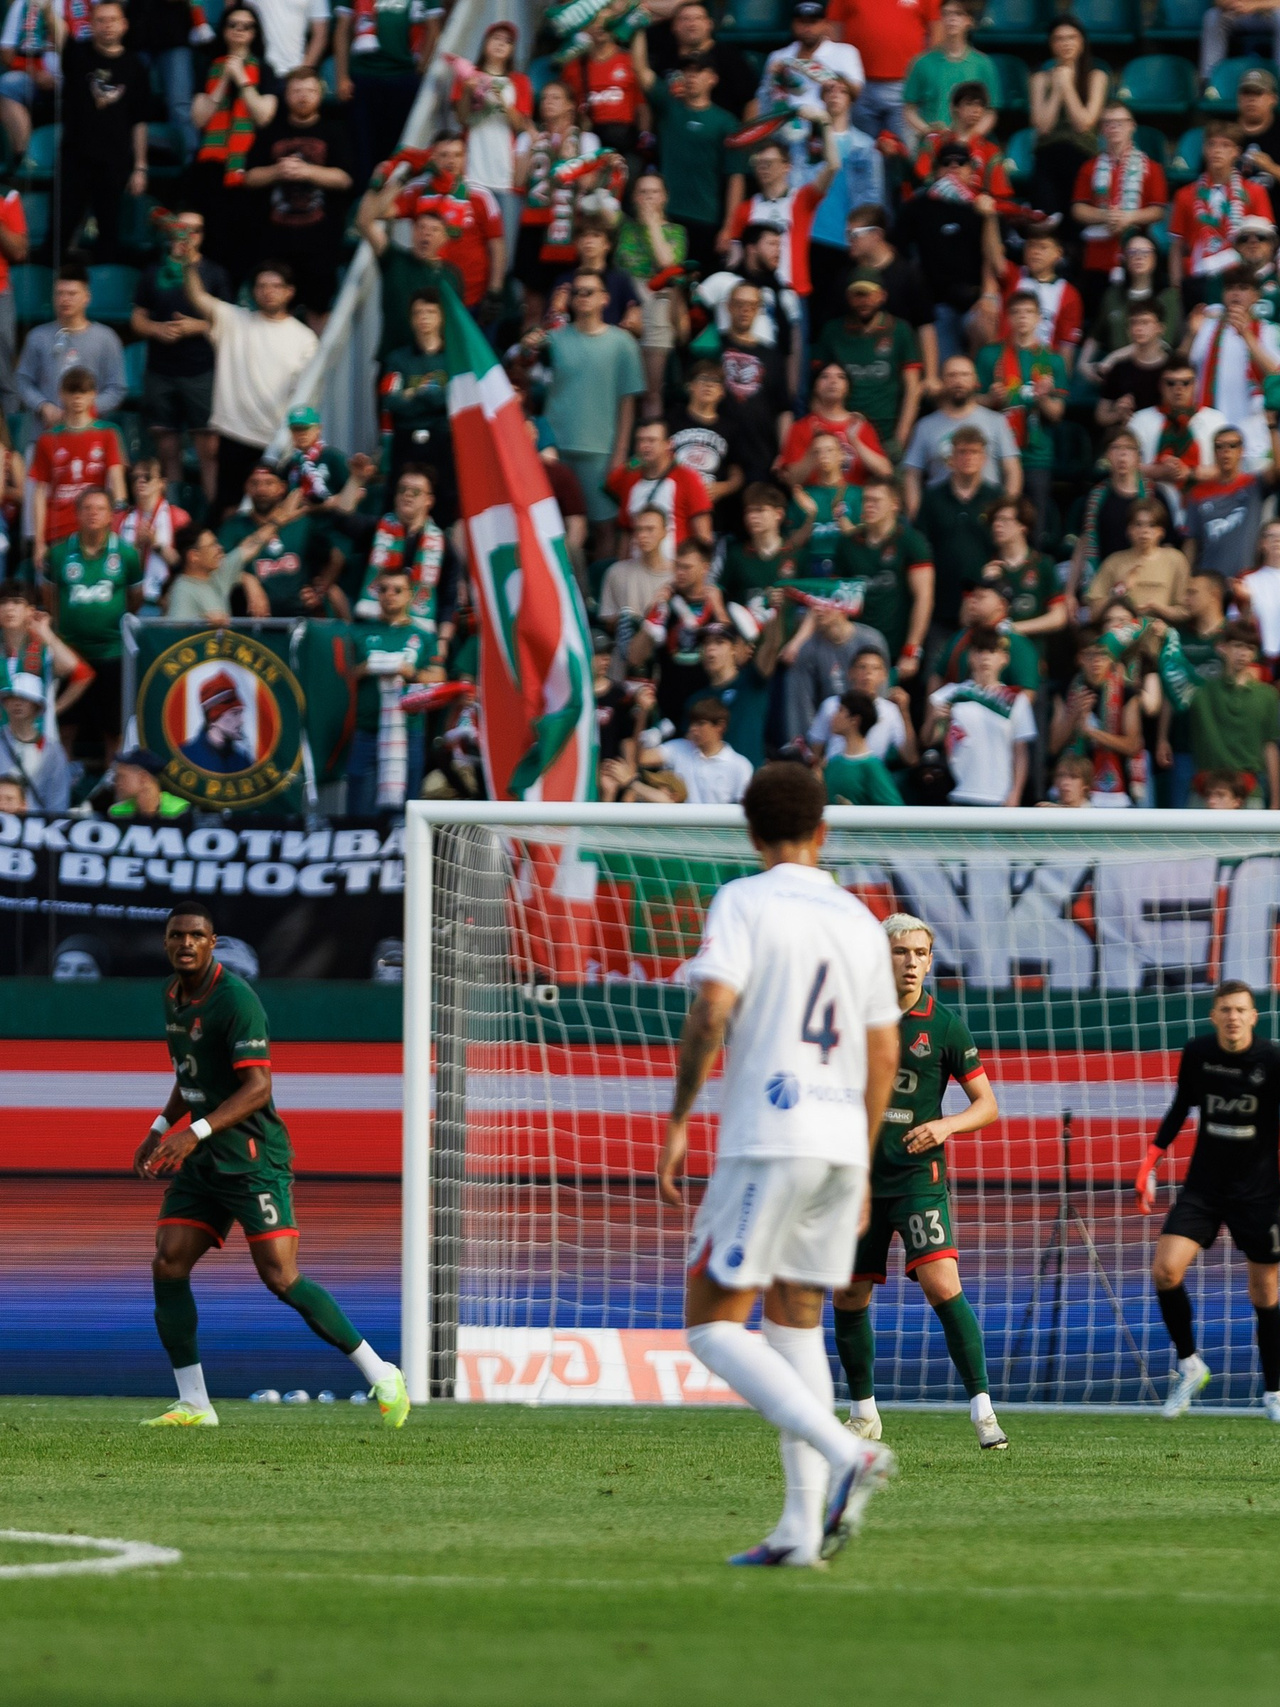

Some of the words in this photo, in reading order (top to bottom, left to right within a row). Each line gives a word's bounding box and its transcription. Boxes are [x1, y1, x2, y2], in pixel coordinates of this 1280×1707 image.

[800, 960, 840, 1066] 4
[258, 1193, 279, 1225] 5
[909, 1209, 946, 1249] 83
